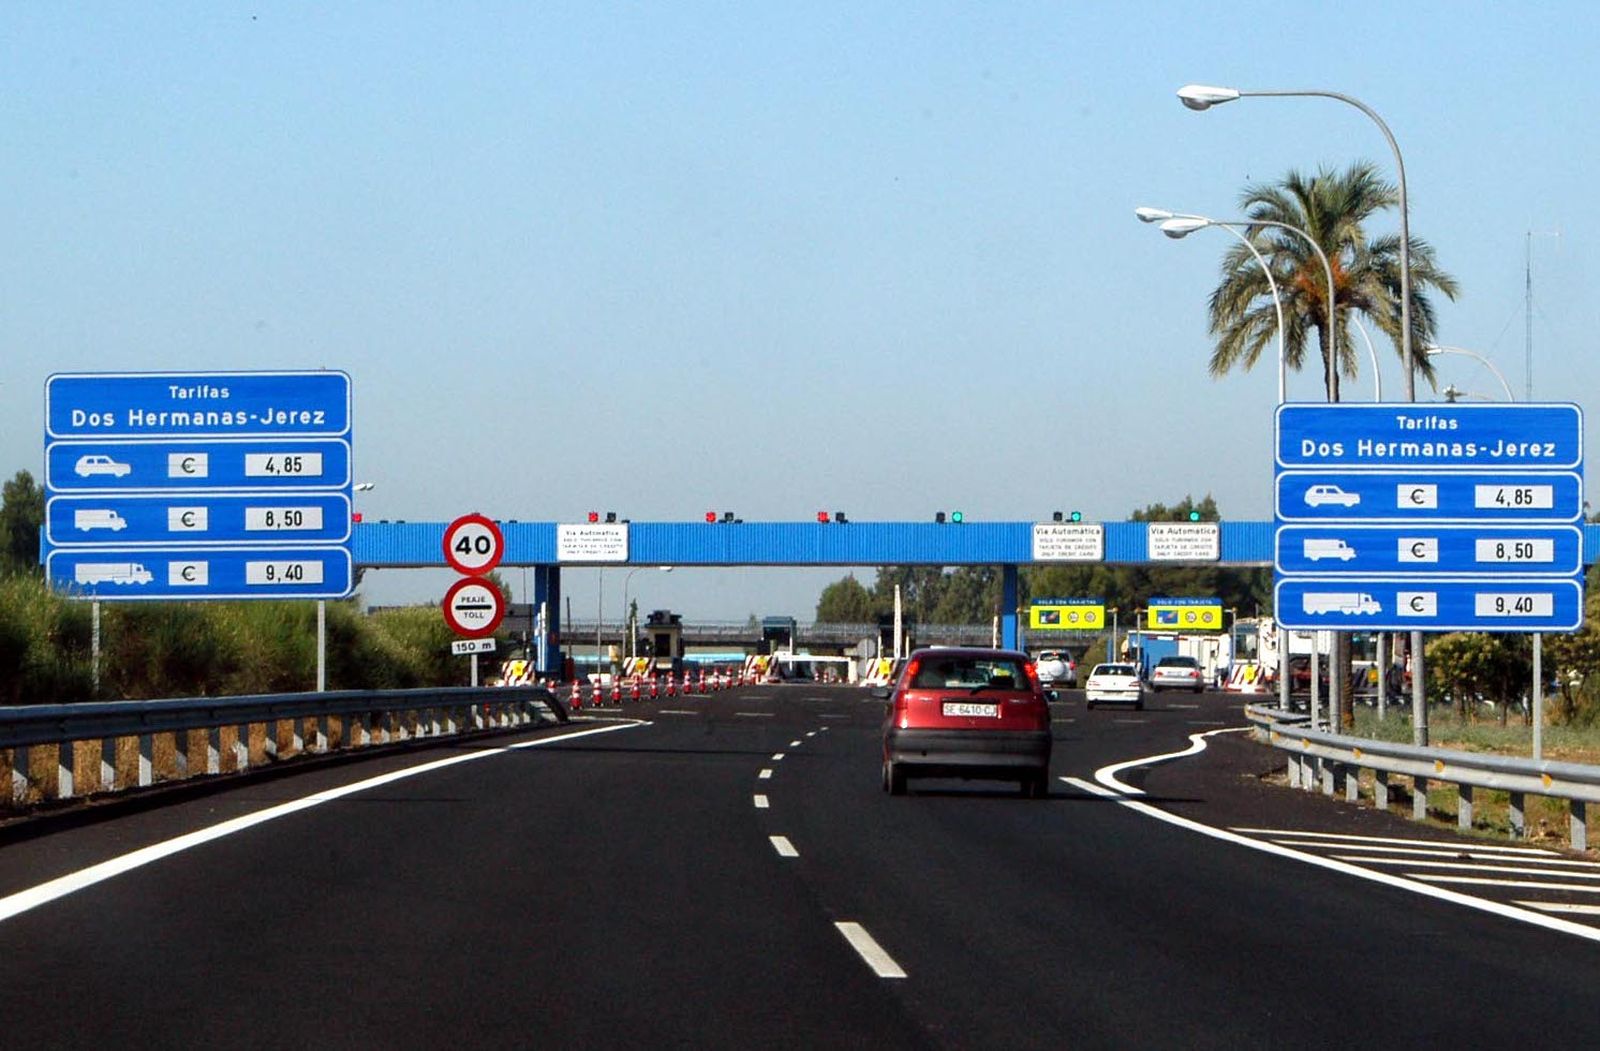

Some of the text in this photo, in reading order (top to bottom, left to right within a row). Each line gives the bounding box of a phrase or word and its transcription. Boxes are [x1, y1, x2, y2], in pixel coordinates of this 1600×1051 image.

[169, 385, 230, 399] Tarifas
[72, 407, 326, 427] Dos Hermanas-Jerez
[1397, 415, 1458, 430] Tarifas
[1301, 439, 1556, 457] Dos Hermanas-Jerez
[181, 456, 302, 476] € 4,85
[1410, 488, 1533, 507] € 4,85
[181, 510, 303, 530] € 8,50
[455, 535, 491, 555] 40
[1411, 542, 1534, 562] € 8,50
[181, 564, 303, 584] € 9,40
[464, 611, 485, 619] TOLL
[1410, 596, 1533, 616] € 9,40
[456, 641, 492, 652] 150 m
[945, 704, 955, 713] SE
